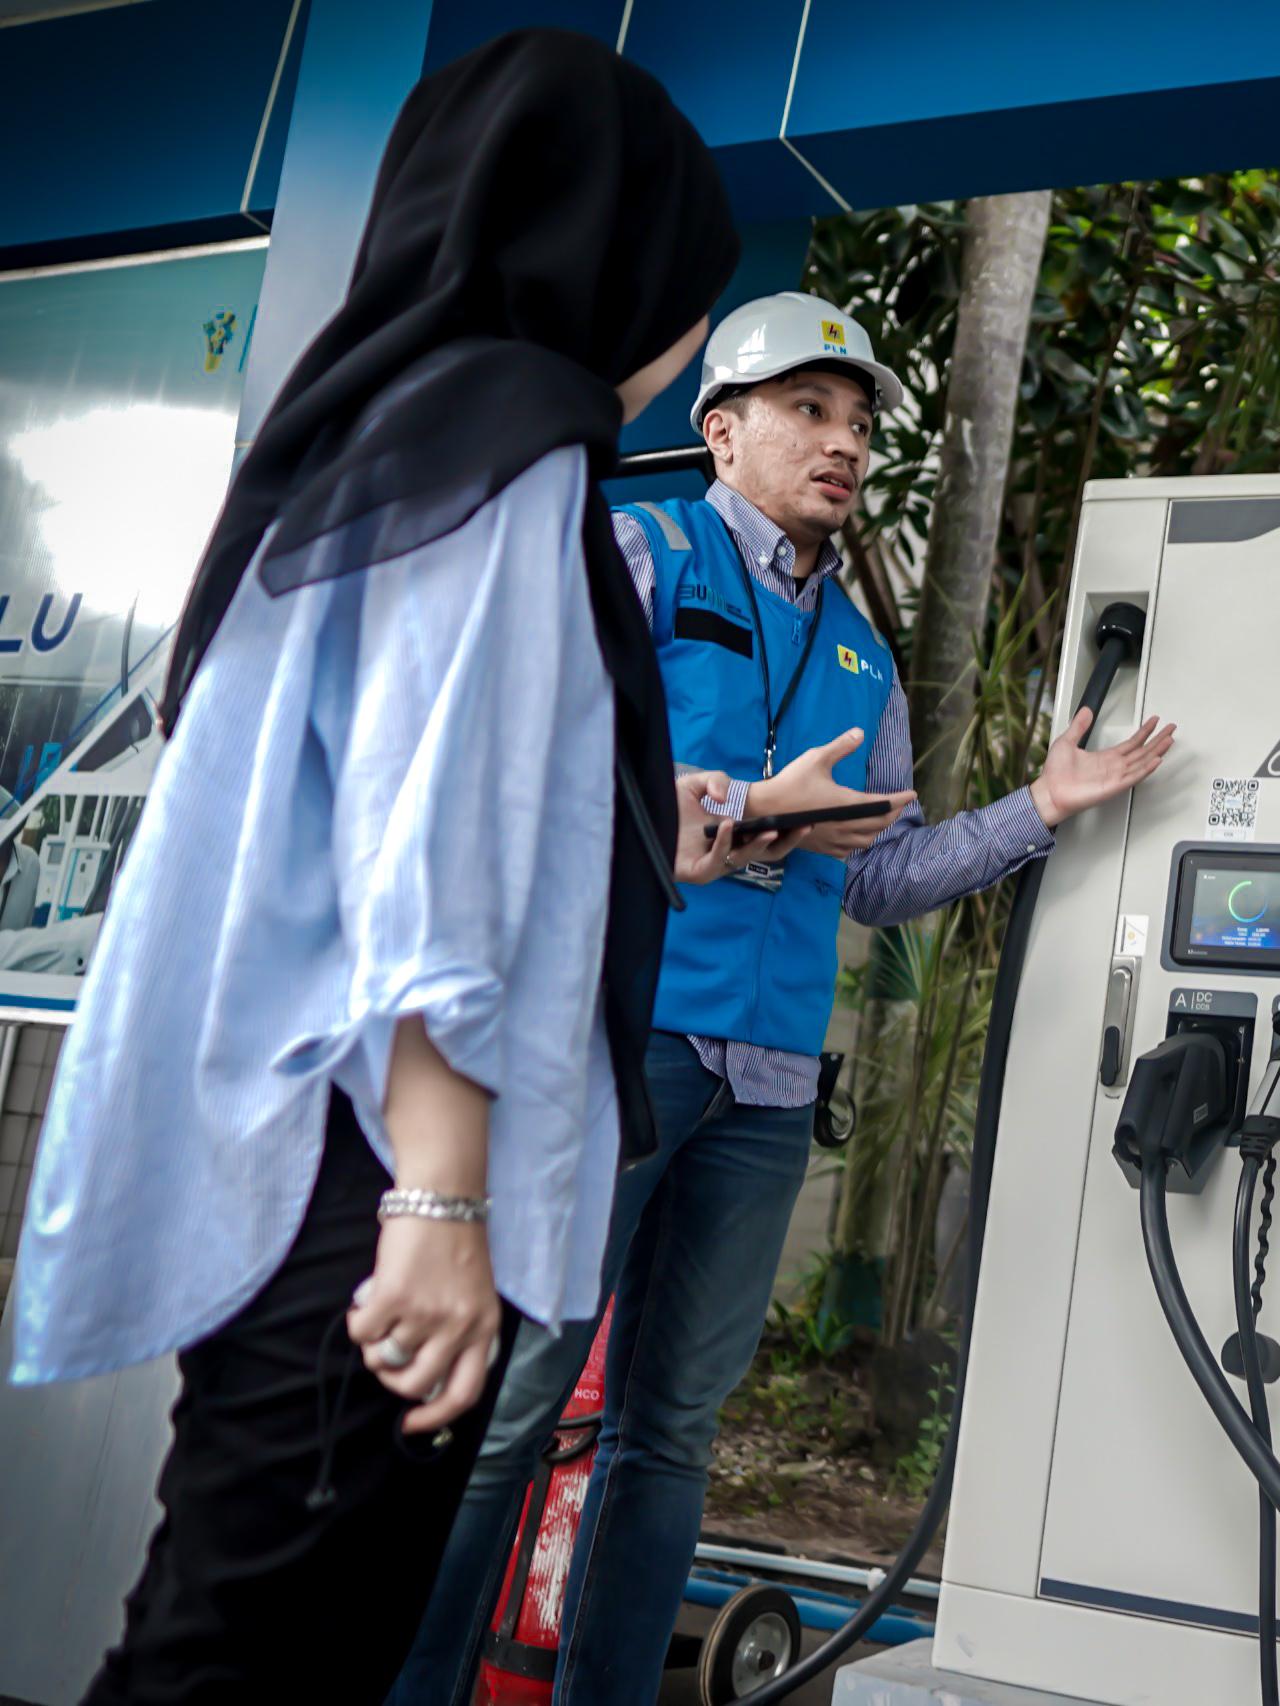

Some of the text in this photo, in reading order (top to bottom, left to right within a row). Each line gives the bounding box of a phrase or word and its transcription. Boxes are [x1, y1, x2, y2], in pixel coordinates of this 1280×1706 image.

[823, 343, 847, 355] PLN
[1175, 991, 1213, 1008] A DC
